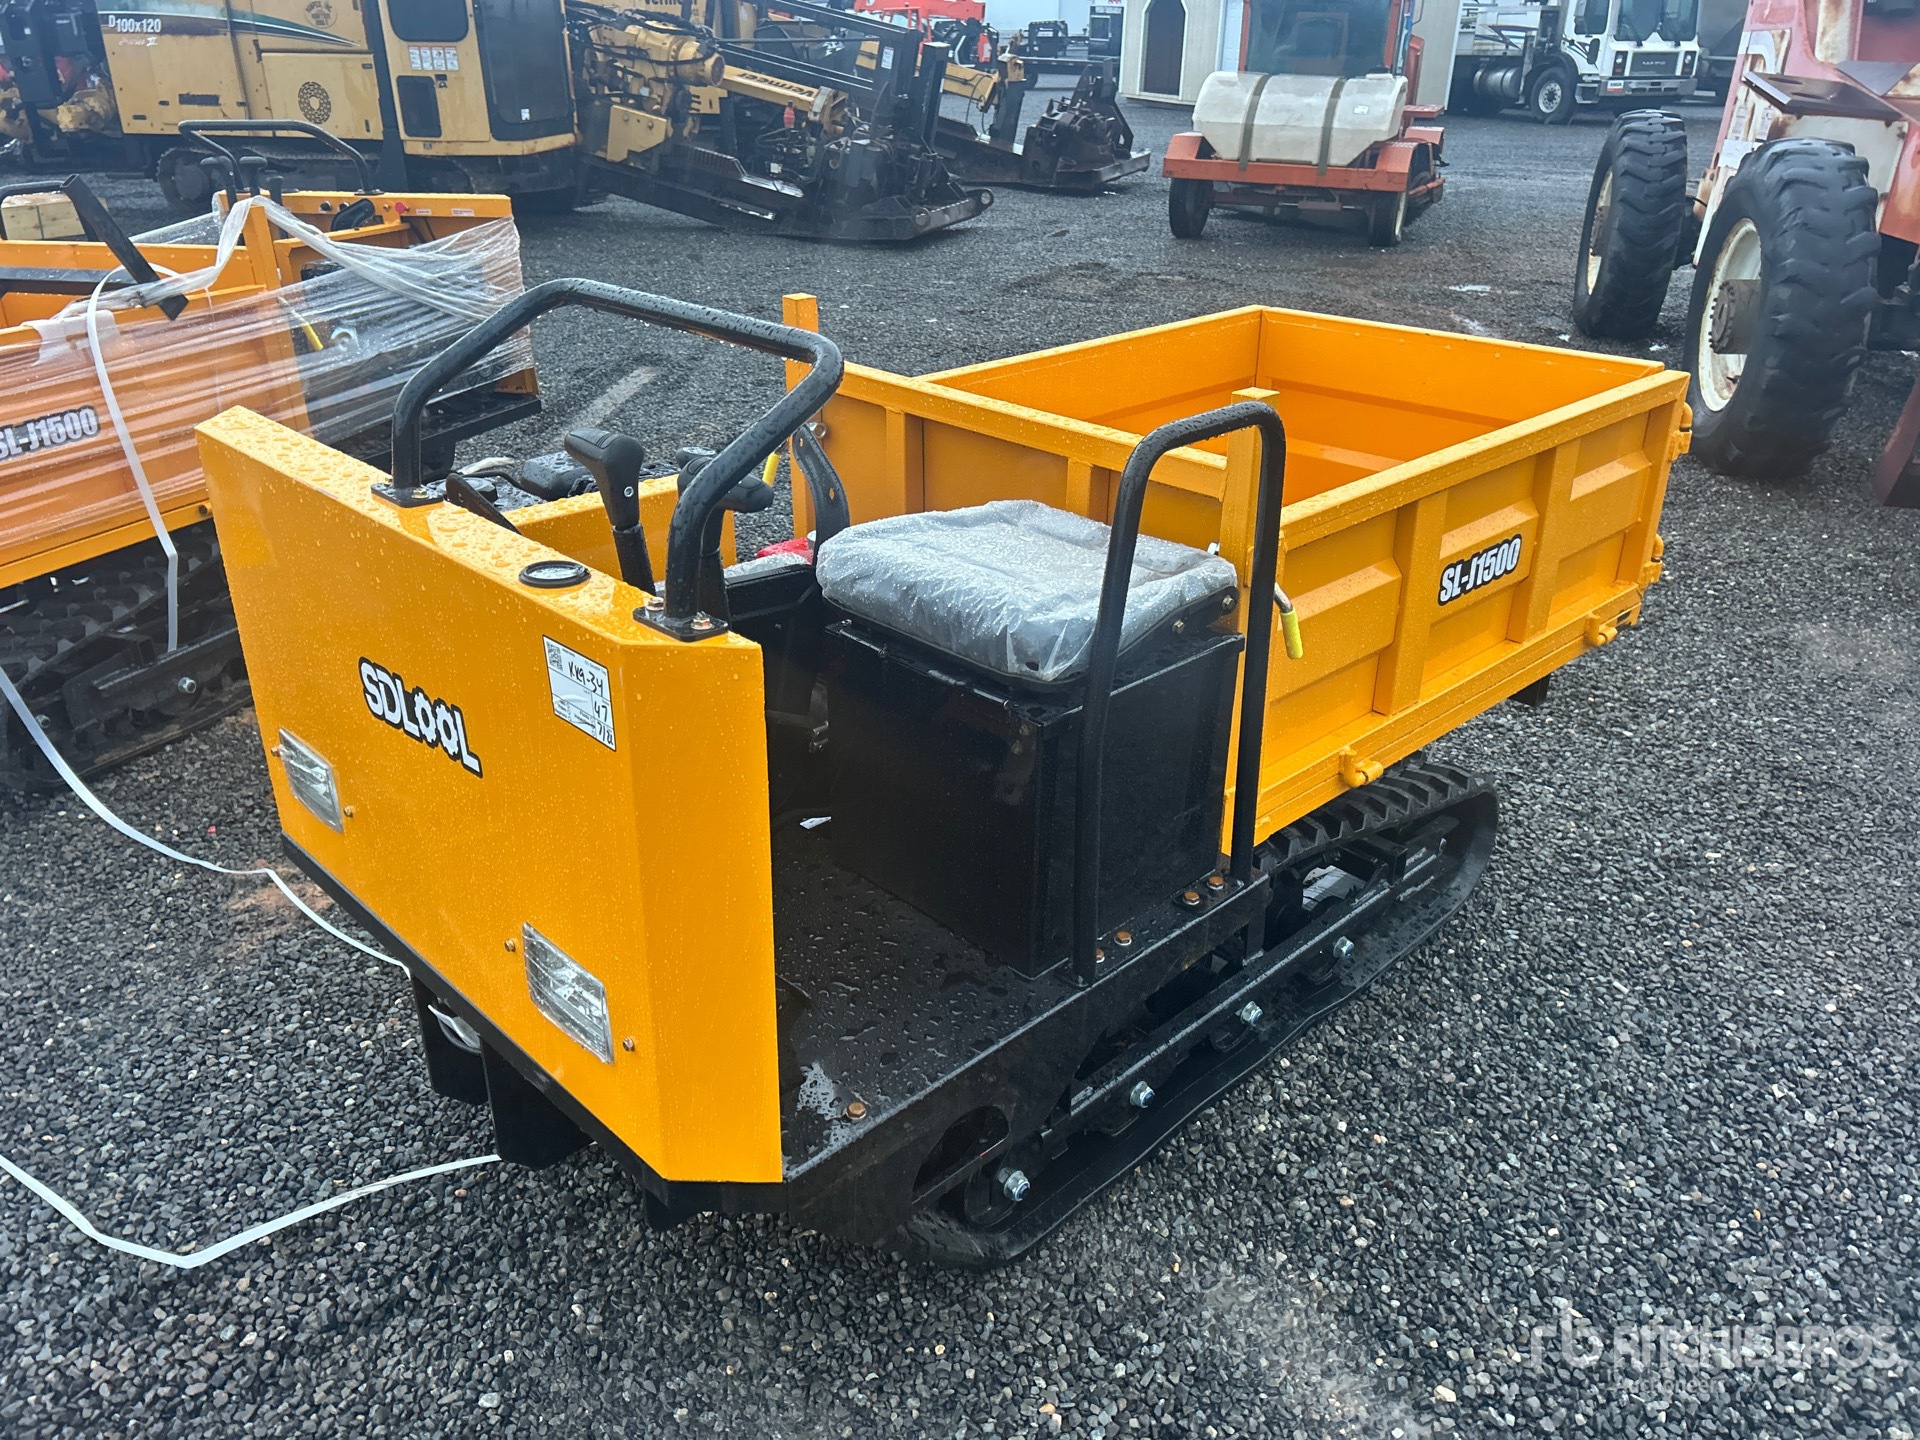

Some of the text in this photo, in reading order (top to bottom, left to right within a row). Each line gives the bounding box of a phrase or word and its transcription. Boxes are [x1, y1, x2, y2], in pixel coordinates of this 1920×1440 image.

[737, 72, 815, 98] Vermeer
[1439, 535, 1522, 605] SL-J1500
[359, 657, 482, 777] SDLOOL
[594, 701, 608, 723] 47
